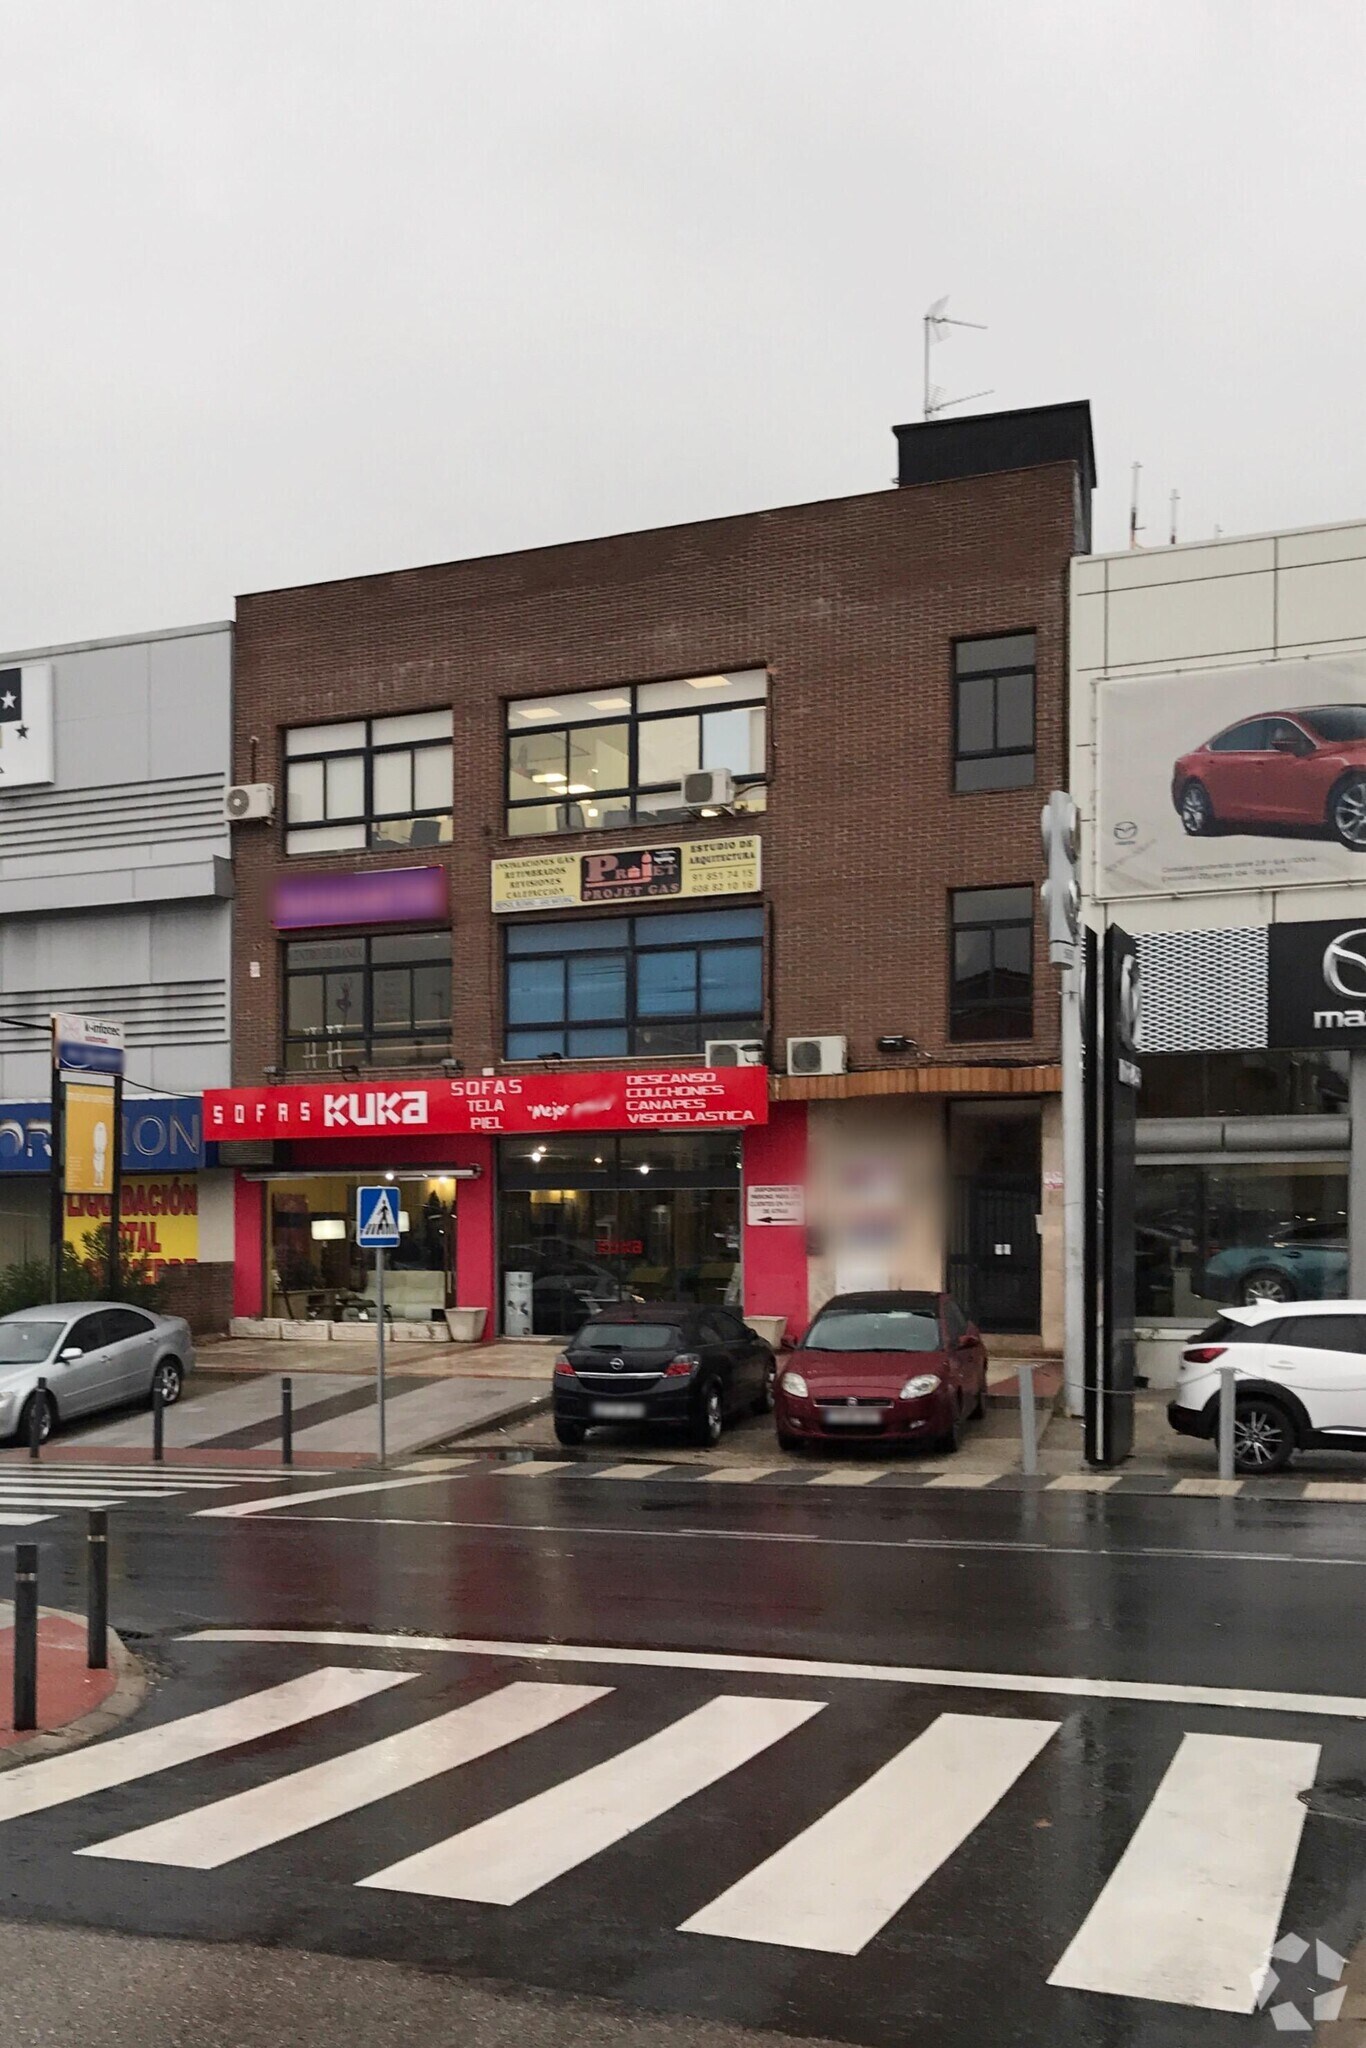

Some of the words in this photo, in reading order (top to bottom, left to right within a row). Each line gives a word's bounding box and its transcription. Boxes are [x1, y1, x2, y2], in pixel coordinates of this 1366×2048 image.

[690, 841, 736, 853] ESTUDIO
[739, 840, 753, 848] DE
[690, 852, 755, 865] ARQUITECTURA
[583, 886, 642, 900] PROJET
[648, 883, 680, 895] GAS
[1313, 1010, 1366, 1028] ma
[626, 1072, 716, 1085] DESCANSO
[451, 1079, 522, 1096] SOFAS
[626, 1085, 725, 1098] COLCHONES
[466, 1099, 505, 1112] TELA
[626, 1098, 706, 1111] CANAPES
[213, 1102, 311, 1124] SOFAS
[627, 1110, 755, 1124] VISCOELASTICA
[470, 1116, 504, 1129] PIEL
